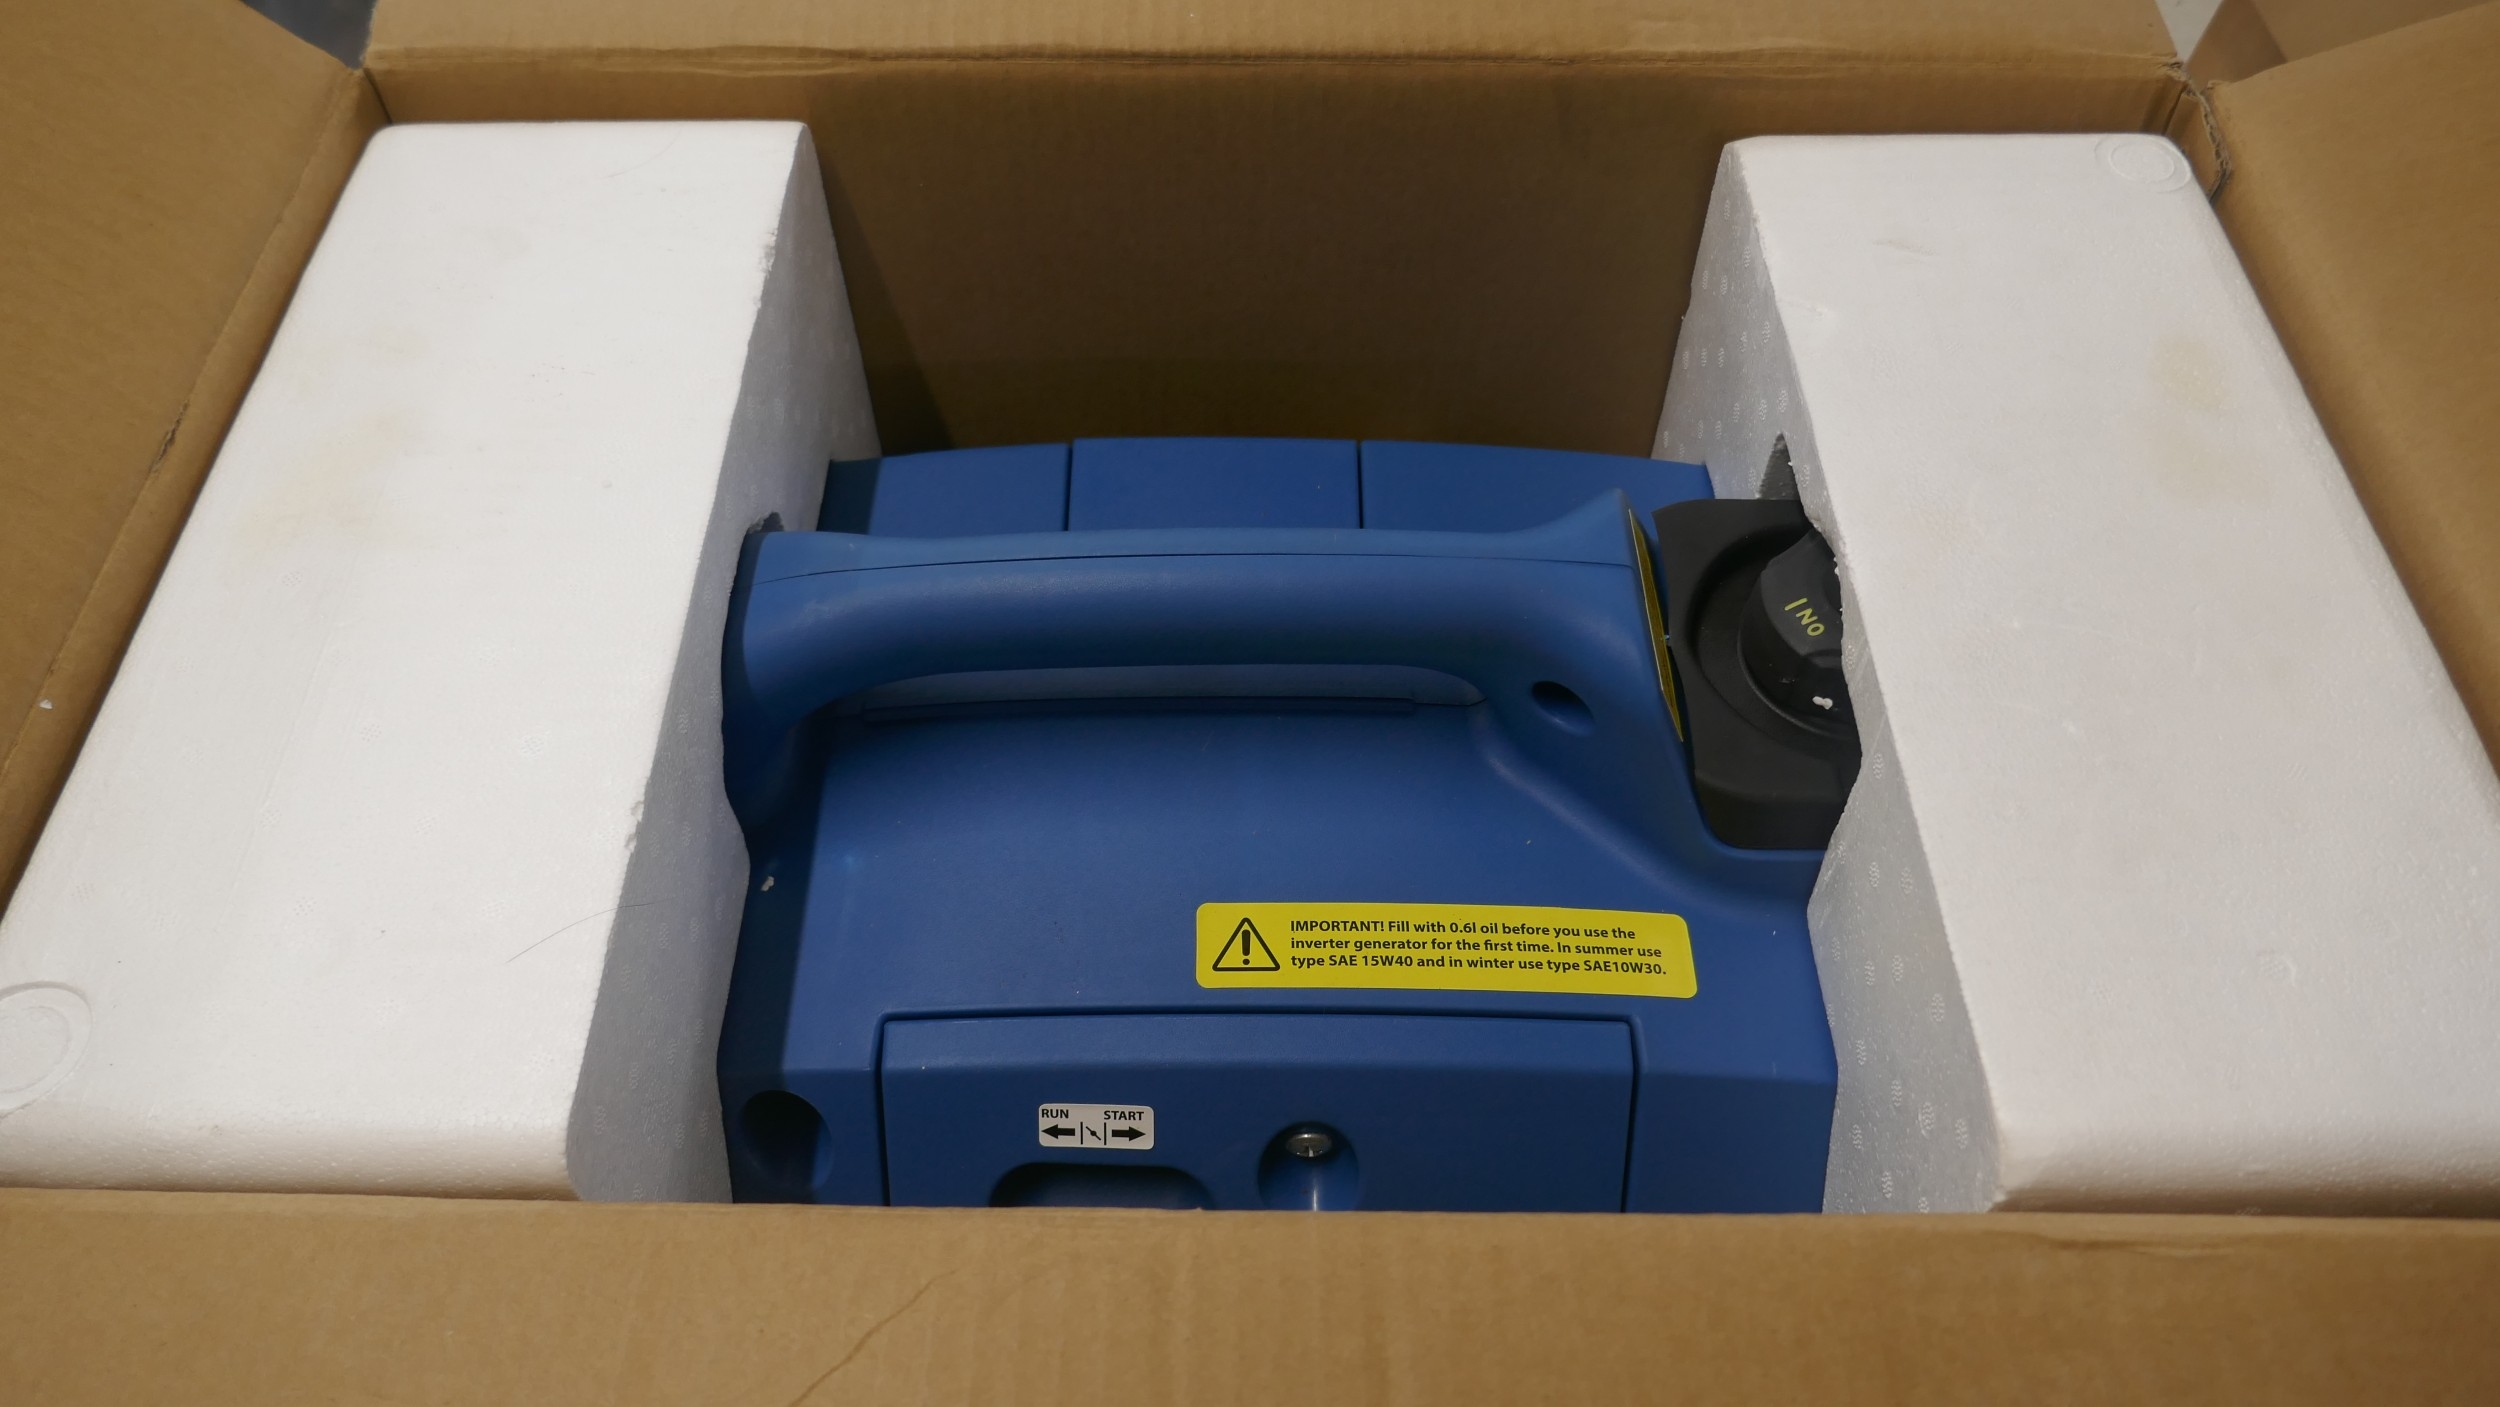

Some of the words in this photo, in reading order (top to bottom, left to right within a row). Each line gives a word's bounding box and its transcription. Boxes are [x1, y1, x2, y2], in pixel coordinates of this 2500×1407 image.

[1291, 921, 1384, 932] IMPORTANT!
[1388, 921, 1410, 932] Fill
[1414, 921, 1446, 933] with
[1480, 923, 1498, 934] oil
[1502, 923, 1550, 935] before
[1553, 927, 1580, 938] you
[1584, 928, 1608, 938] use
[1612, 927, 1635, 939] the
[1291, 938, 1350, 949] inverter
[1354, 939, 1427, 951] generator
[1431, 938, 1452, 950] for
[1456, 939, 1480, 950] the
[1484, 940, 1513, 951] first
[1516, 941, 1554, 953] time.
[1558, 942, 1571, 953] In
[1575, 944, 1633, 956] summer
[1637, 947, 1662, 957] use
[1291, 955, 1325, 968] type
[1329, 955, 1357, 966] SAE
[1362, 955, 1413, 966] 15W40
[1417, 956, 1445, 967] and
[1449, 957, 1463, 967] in
[1467, 957, 1514, 969] winter
[1518, 960, 1543, 969] use
[1547, 959, 1580, 973] type
[1584, 960, 1667, 975] SAE10W30.
[1041, 1108, 1069, 1119] RUN
[1103, 1110, 1144, 1121] START
